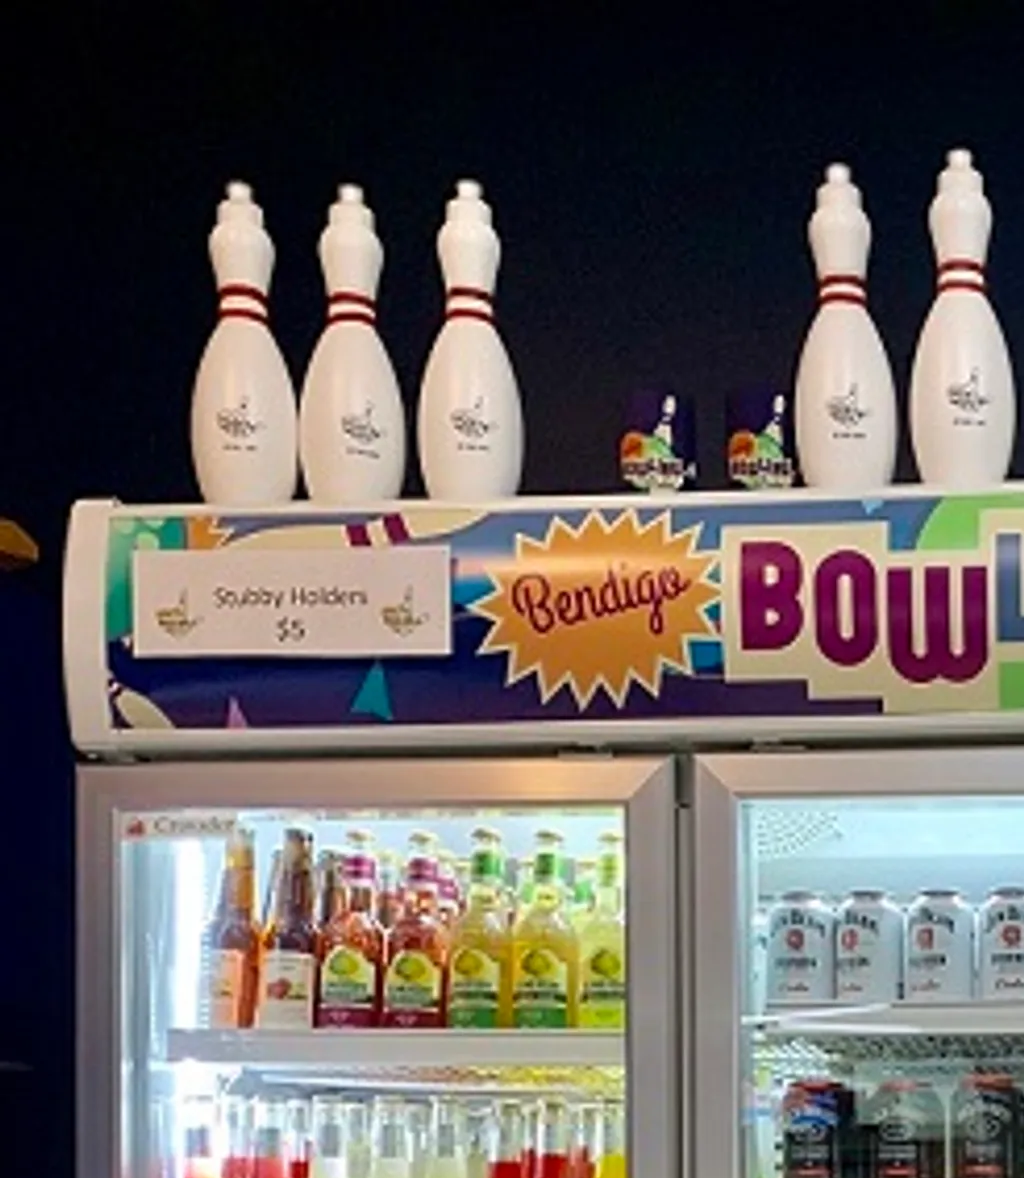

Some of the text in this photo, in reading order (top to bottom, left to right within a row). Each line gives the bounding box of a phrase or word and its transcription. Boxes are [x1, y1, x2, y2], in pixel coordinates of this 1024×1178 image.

[213, 585, 368, 609] Stubby Holders
[511, 560, 692, 634] Bendigo
[275, 616, 306, 642] $5
